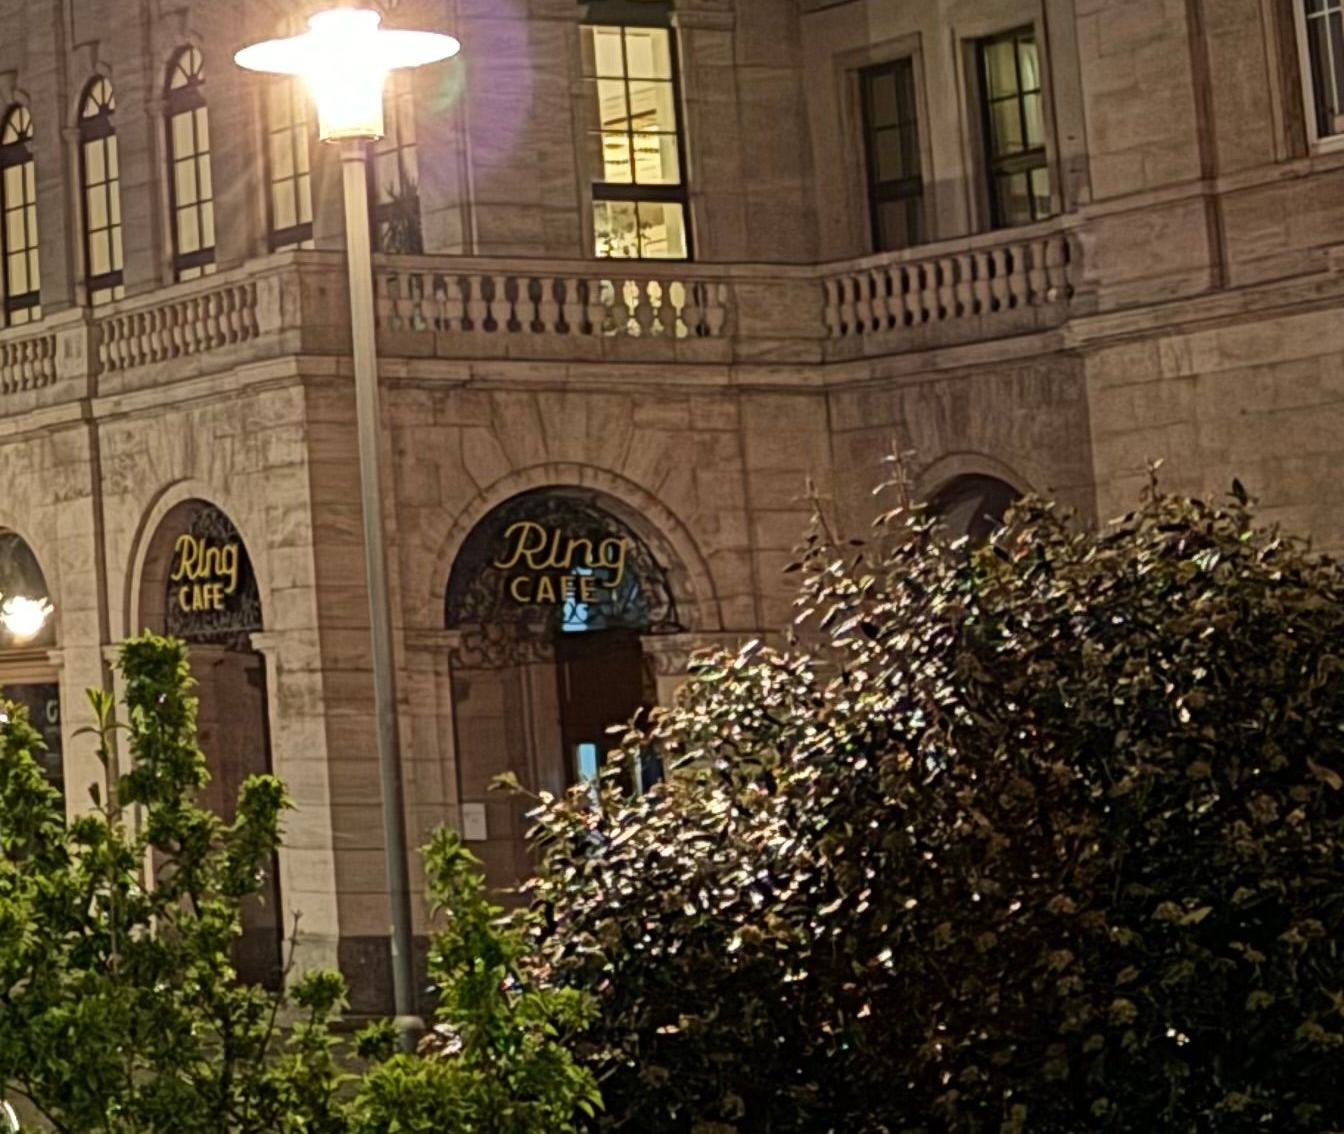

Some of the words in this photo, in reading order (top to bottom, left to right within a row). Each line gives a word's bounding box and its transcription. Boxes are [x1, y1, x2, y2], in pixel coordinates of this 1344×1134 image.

[170, 534, 239, 594] Ring
[493, 520, 631, 588] Ring
[178, 583, 225, 612] CAFE
[510, 575, 599, 603] CAFE
